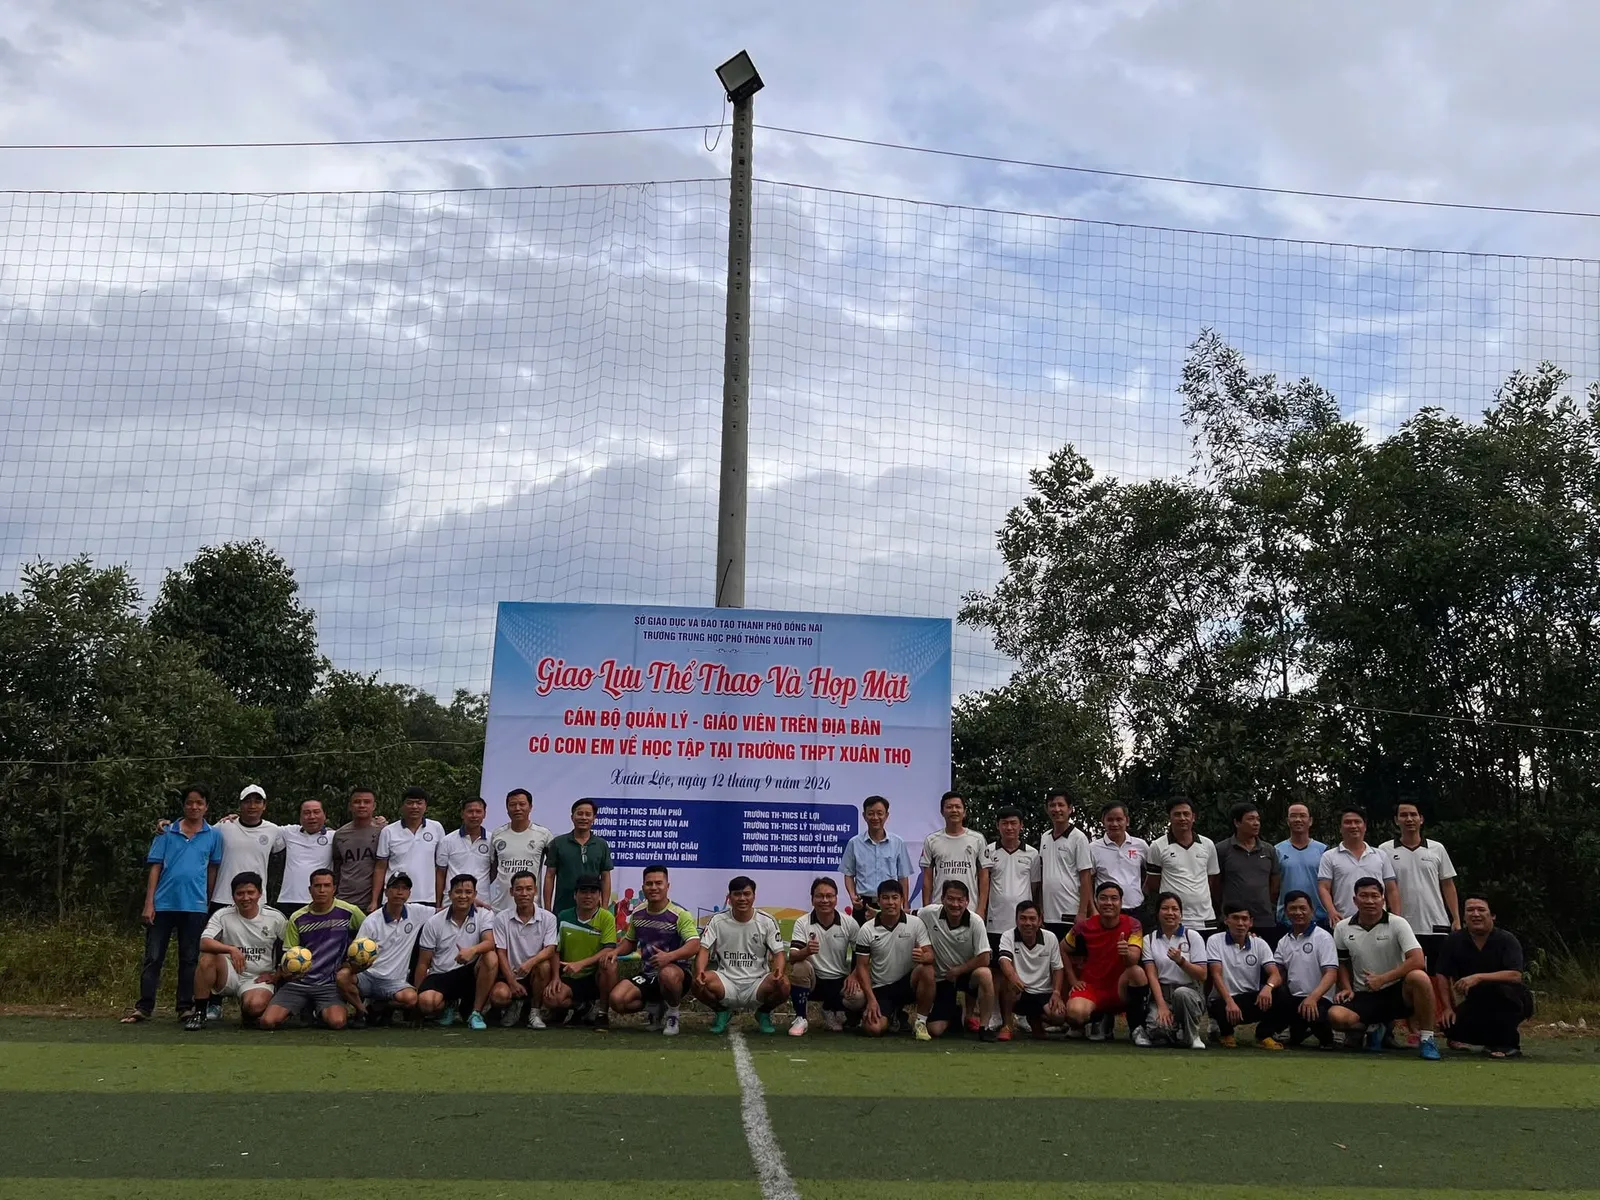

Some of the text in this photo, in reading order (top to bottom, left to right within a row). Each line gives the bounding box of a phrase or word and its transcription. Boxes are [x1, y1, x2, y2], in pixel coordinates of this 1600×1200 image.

[669, 617, 686, 628] DỤC
[720, 619, 735, 630] TẠO
[808, 623, 823, 632] NAI
[678, 632, 705, 642] TRUNG
[707, 633, 724, 644] HỌC
[797, 637, 813, 648] THỌ
[536, 657, 912, 707] Giao Lưu Thể Thao Và Họp Mặt
[564, 706, 596, 726] CÁN
[600, 707, 621, 730] BỘ
[625, 706, 667, 729] QUẢN
[671, 709, 689, 730] LÝ
[703, 711, 738, 731] GIÁO
[742, 712, 776, 732] VIÊN
[780, 713, 818, 733] TRÊN
[822, 718, 846, 737] ĐỊA
[851, 716, 881, 736] BÀN
[529, 733, 911, 767] CÓ CON EM VỀ HỌC TẬP TẠI TRƯỜNG THPT XUÂN THỌ
[610, 768, 831, 792] Xuân Lộc, ngày 12 tháng 9 năm 2026
[597, 806, 618, 815] ƯỜNG
[620, 807, 648, 816] TH-THCS
[771, 811, 798, 820] TH-THCS
[800, 811, 808, 820] LÊ
[592, 817, 618, 826] RƯỜNG
[619, 818, 647, 827] TH-THCS
[648, 819, 662, 827] CHU
[678, 820, 689, 828] AN
[770, 822, 798, 830] TH-THCS
[618, 829, 646, 838] TH-THCS
[647, 830, 663, 838] LAM
[770, 833, 798, 842] TH-THCS
[617, 841, 646, 849] TH-THCS
[646, 841, 666, 850] PHAN
[769, 844, 798, 853] TH-THCS
[344, 847, 375, 863] AIA
[616, 852, 634, 860] THCS
[664, 852, 680, 861] THÁI
[769, 855, 798, 864] TH-THCS
[500, 858, 534, 868] Emirates
[940, 860, 972, 869] Emirates
[237, 945, 266, 955] mirates
